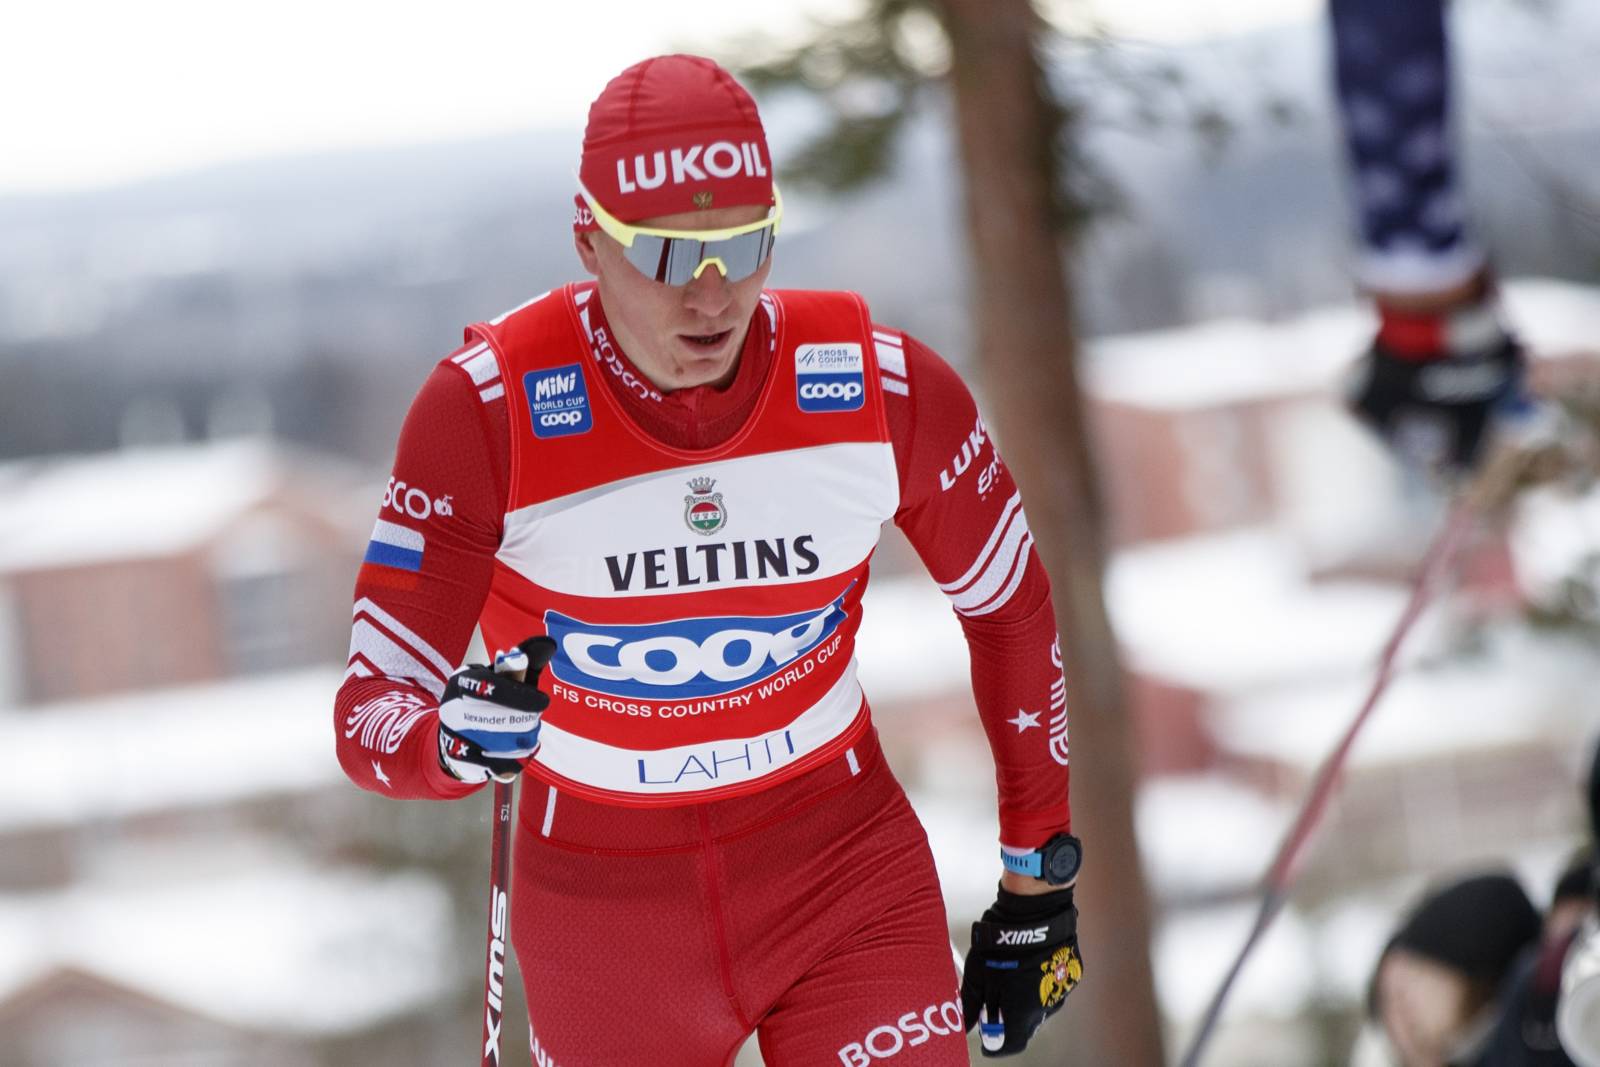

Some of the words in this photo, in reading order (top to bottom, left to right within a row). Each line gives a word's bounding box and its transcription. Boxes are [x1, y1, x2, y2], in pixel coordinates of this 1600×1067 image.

[616, 141, 767, 194] LUKOIL
[533, 400, 565, 411] WORLD
[565, 396, 585, 407] CUP
[540, 410, 582, 427] coop
[799, 381, 862, 401] coop
[939, 412, 987, 492] LUK
[604, 534, 820, 592] VELTINS
[562, 604, 836, 686] coop
[552, 684, 580, 703] FIS
[584, 695, 652, 718] CROSS
[658, 692, 753, 719] COUNTRY
[758, 658, 815, 700] WORLD
[817, 635, 842, 664] CUP
[637, 730, 795, 784] LAHTI
[837, 1000, 963, 1067] BOSCO
